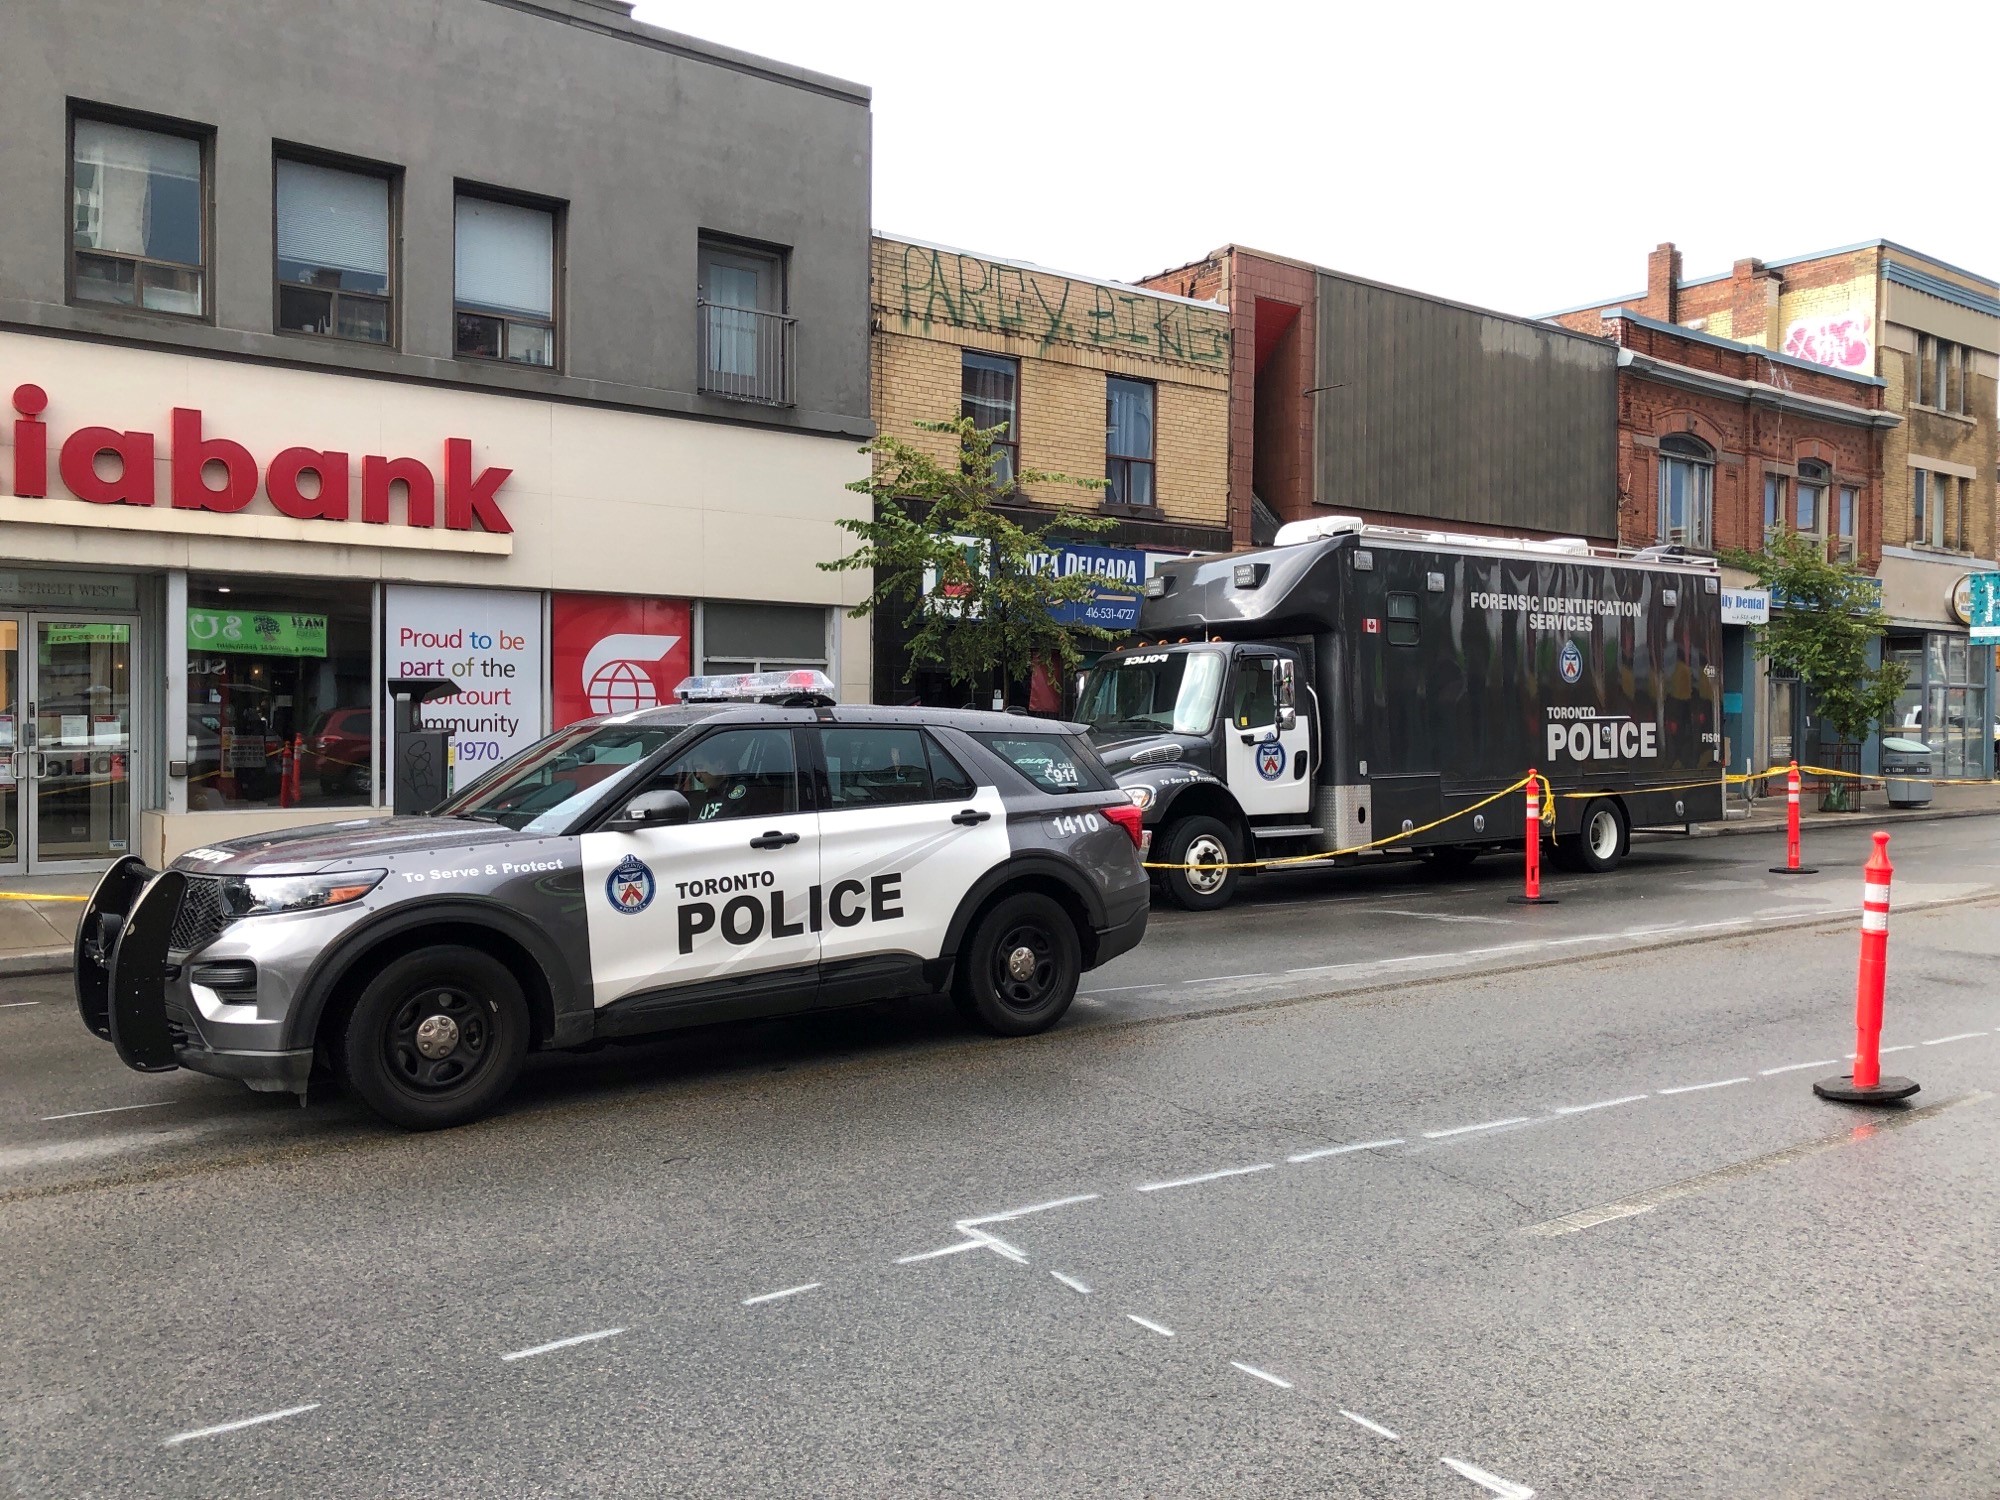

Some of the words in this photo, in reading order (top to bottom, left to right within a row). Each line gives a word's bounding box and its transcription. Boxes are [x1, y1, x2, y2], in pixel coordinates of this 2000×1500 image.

[12, 383, 514, 533] iabank
[1010, 553, 1060, 578] NTA
[79, 583, 119, 598] WEST
[1470, 592, 1540, 612] FORENSIC
[1543, 597, 1642, 617] IDENTIFICATION
[1721, 594, 1733, 609] ily
[1736, 595, 1765, 610] Dental
[1085, 607, 1135, 620] 416-531-4727
[1529, 614, 1593, 631] SERVICES
[401, 628, 462, 648] Proud
[469, 632, 492, 649] to
[500, 630, 525, 650] be
[401, 659, 445, 677] part
[452, 657, 475, 677] of
[481, 658, 516, 677] the
[420, 688, 512, 705] ocourt
[1547, 706, 1596, 720] TORONTO
[420, 713, 520, 737] mmunity
[455, 741, 504, 761] 1970.
[1547, 721, 1658, 761] POLICE
[1052, 813, 1100, 835] 1410
[402, 871, 426, 883] To
[430, 866, 480, 881] Serve
[485, 864, 498, 877] &
[502, 859, 564, 875] Protect
[675, 870, 775, 899] TORONTO
[677, 872, 905, 955] POLICE
